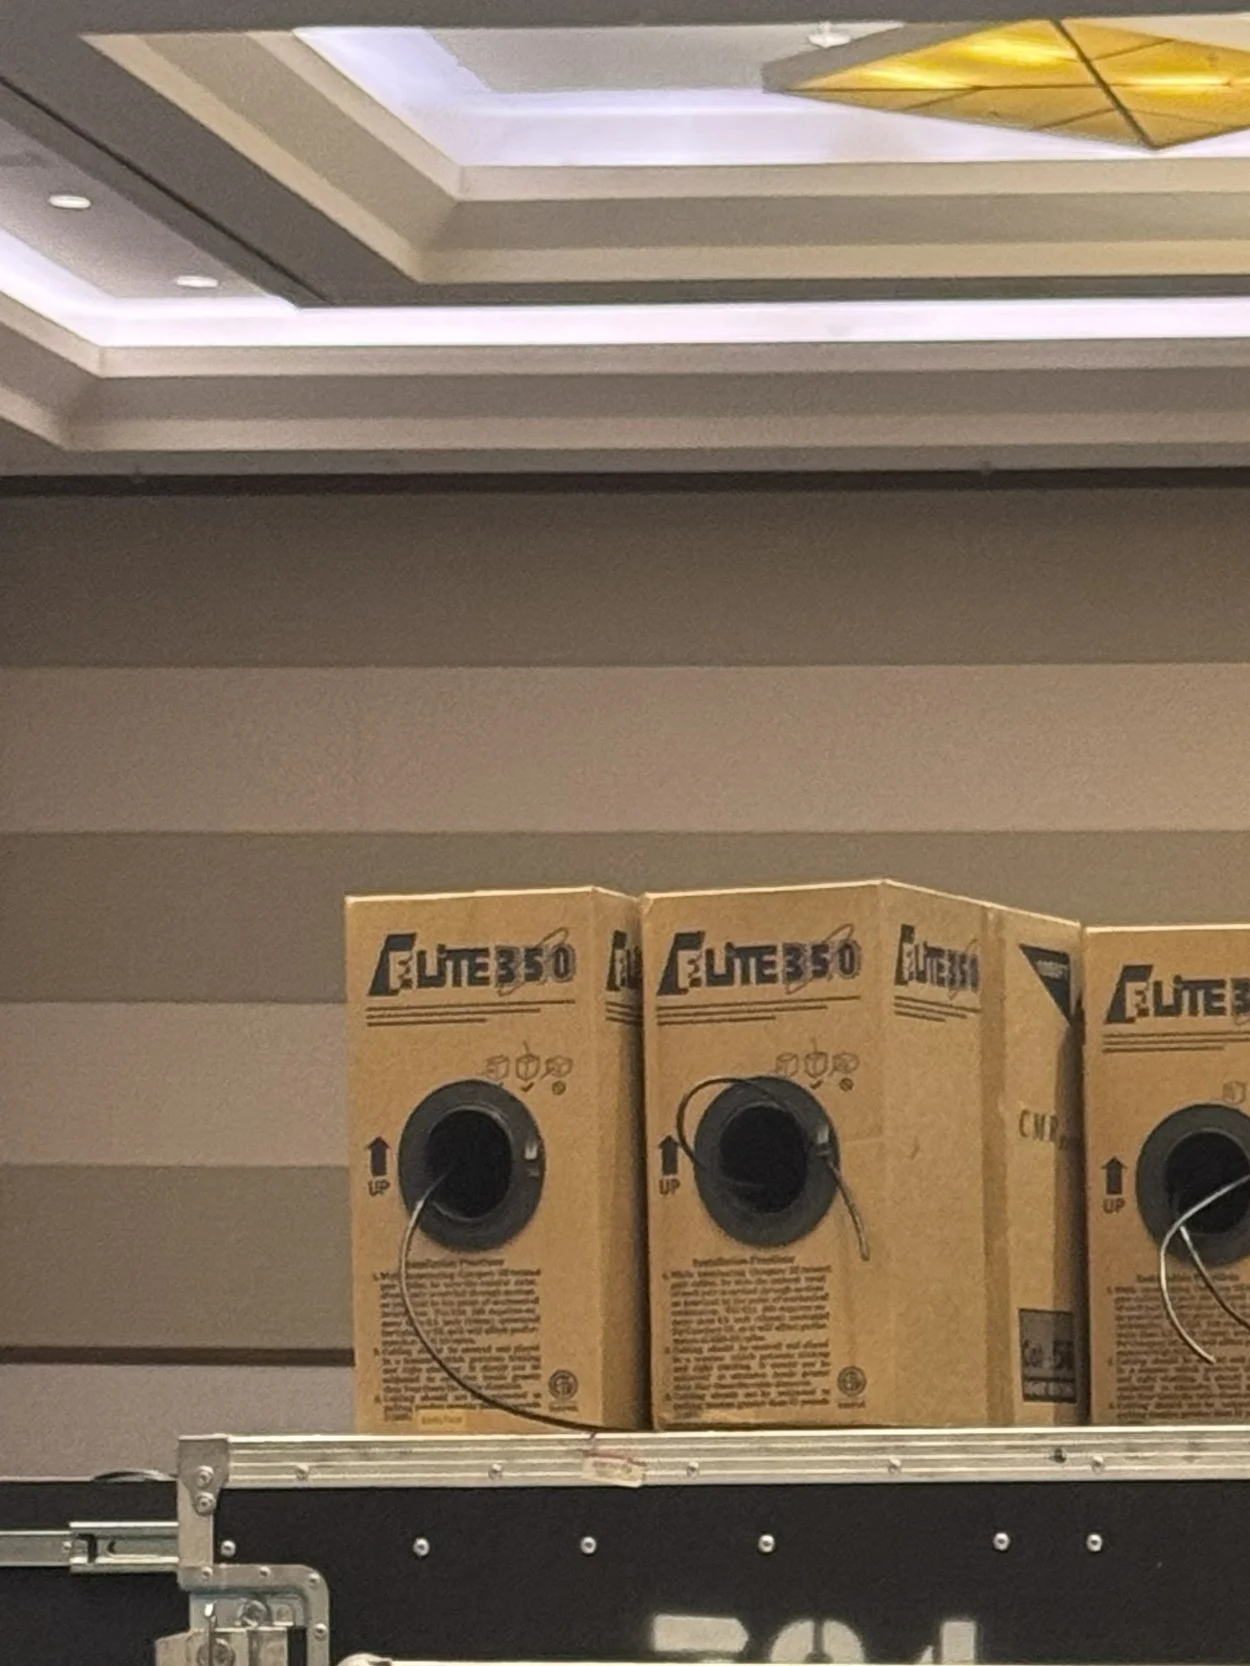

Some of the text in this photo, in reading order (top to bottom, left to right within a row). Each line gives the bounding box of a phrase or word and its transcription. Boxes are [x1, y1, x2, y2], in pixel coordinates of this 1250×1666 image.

[367, 1179, 390, 1197] UP
[658, 1179, 681, 1195] UP
[1102, 1197, 1125, 1214] UP
